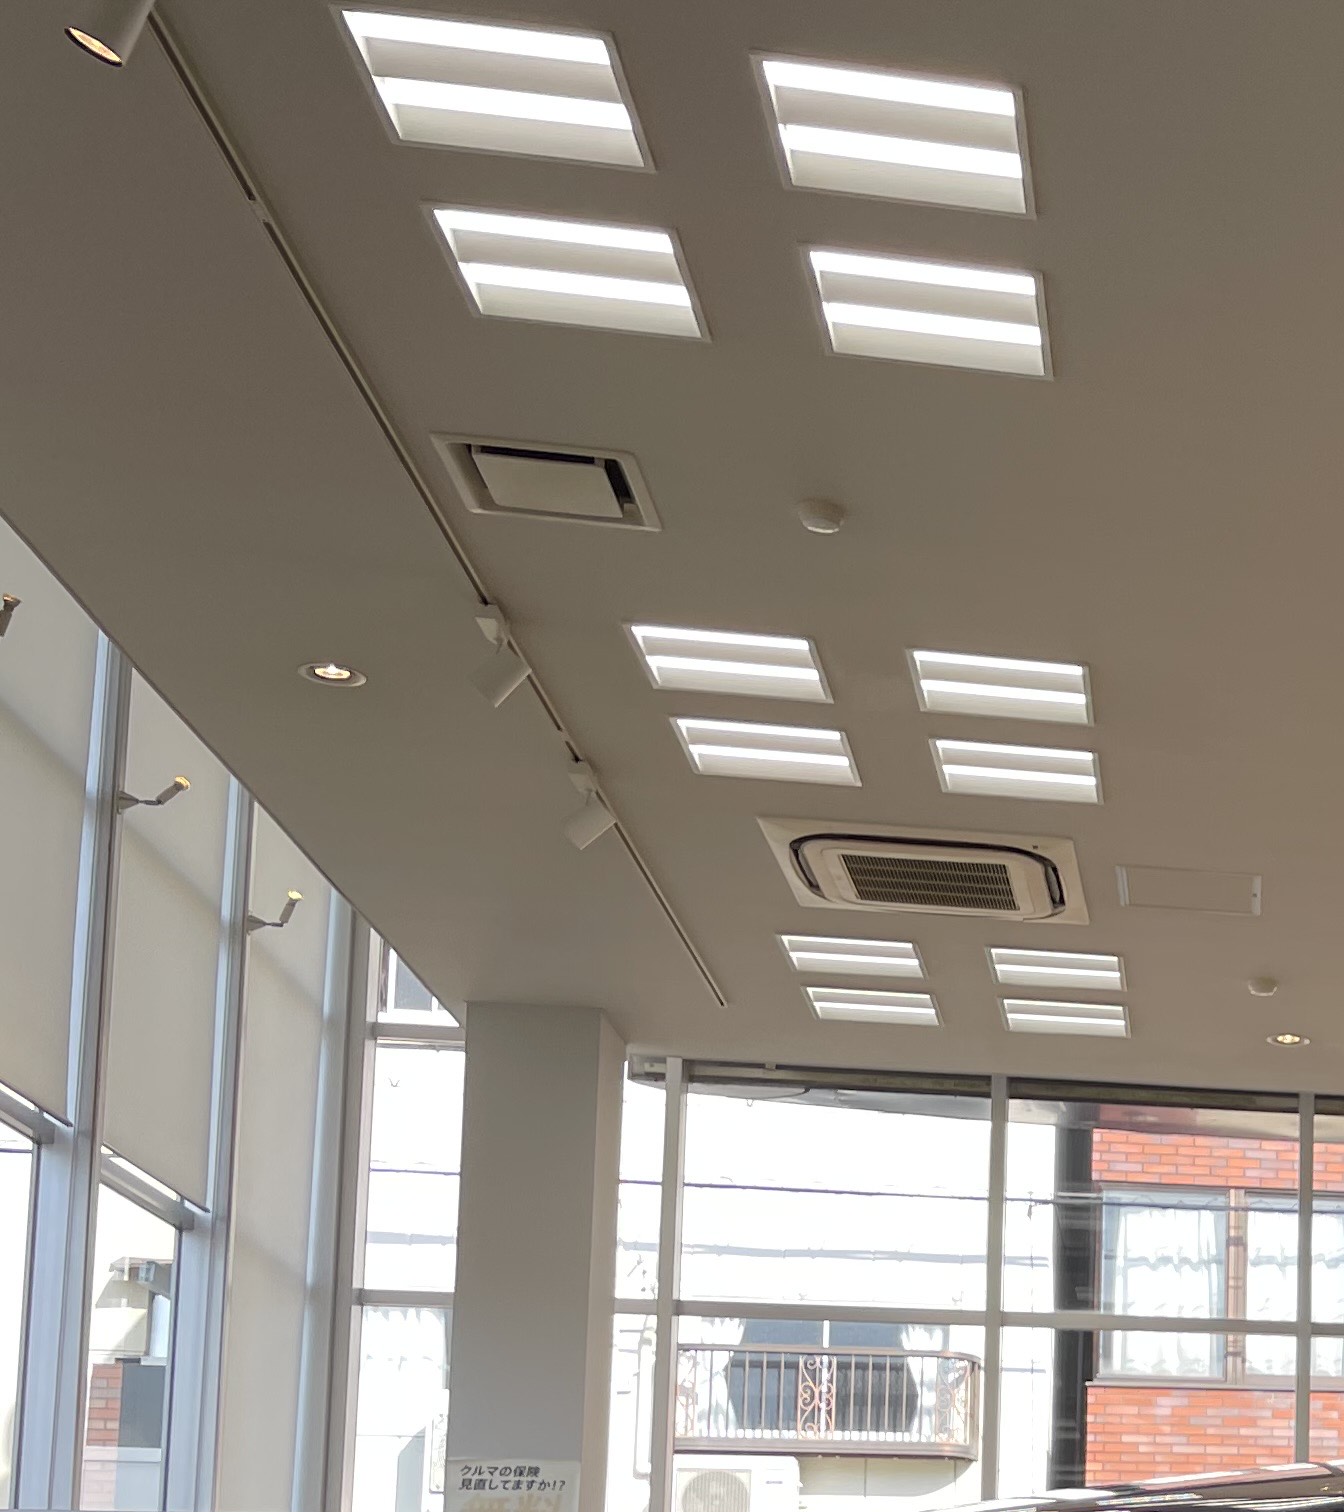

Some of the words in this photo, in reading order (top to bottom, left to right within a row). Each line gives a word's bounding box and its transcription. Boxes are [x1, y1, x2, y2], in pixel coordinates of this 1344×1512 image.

[460, 1465, 541, 1478] クルマの保険
